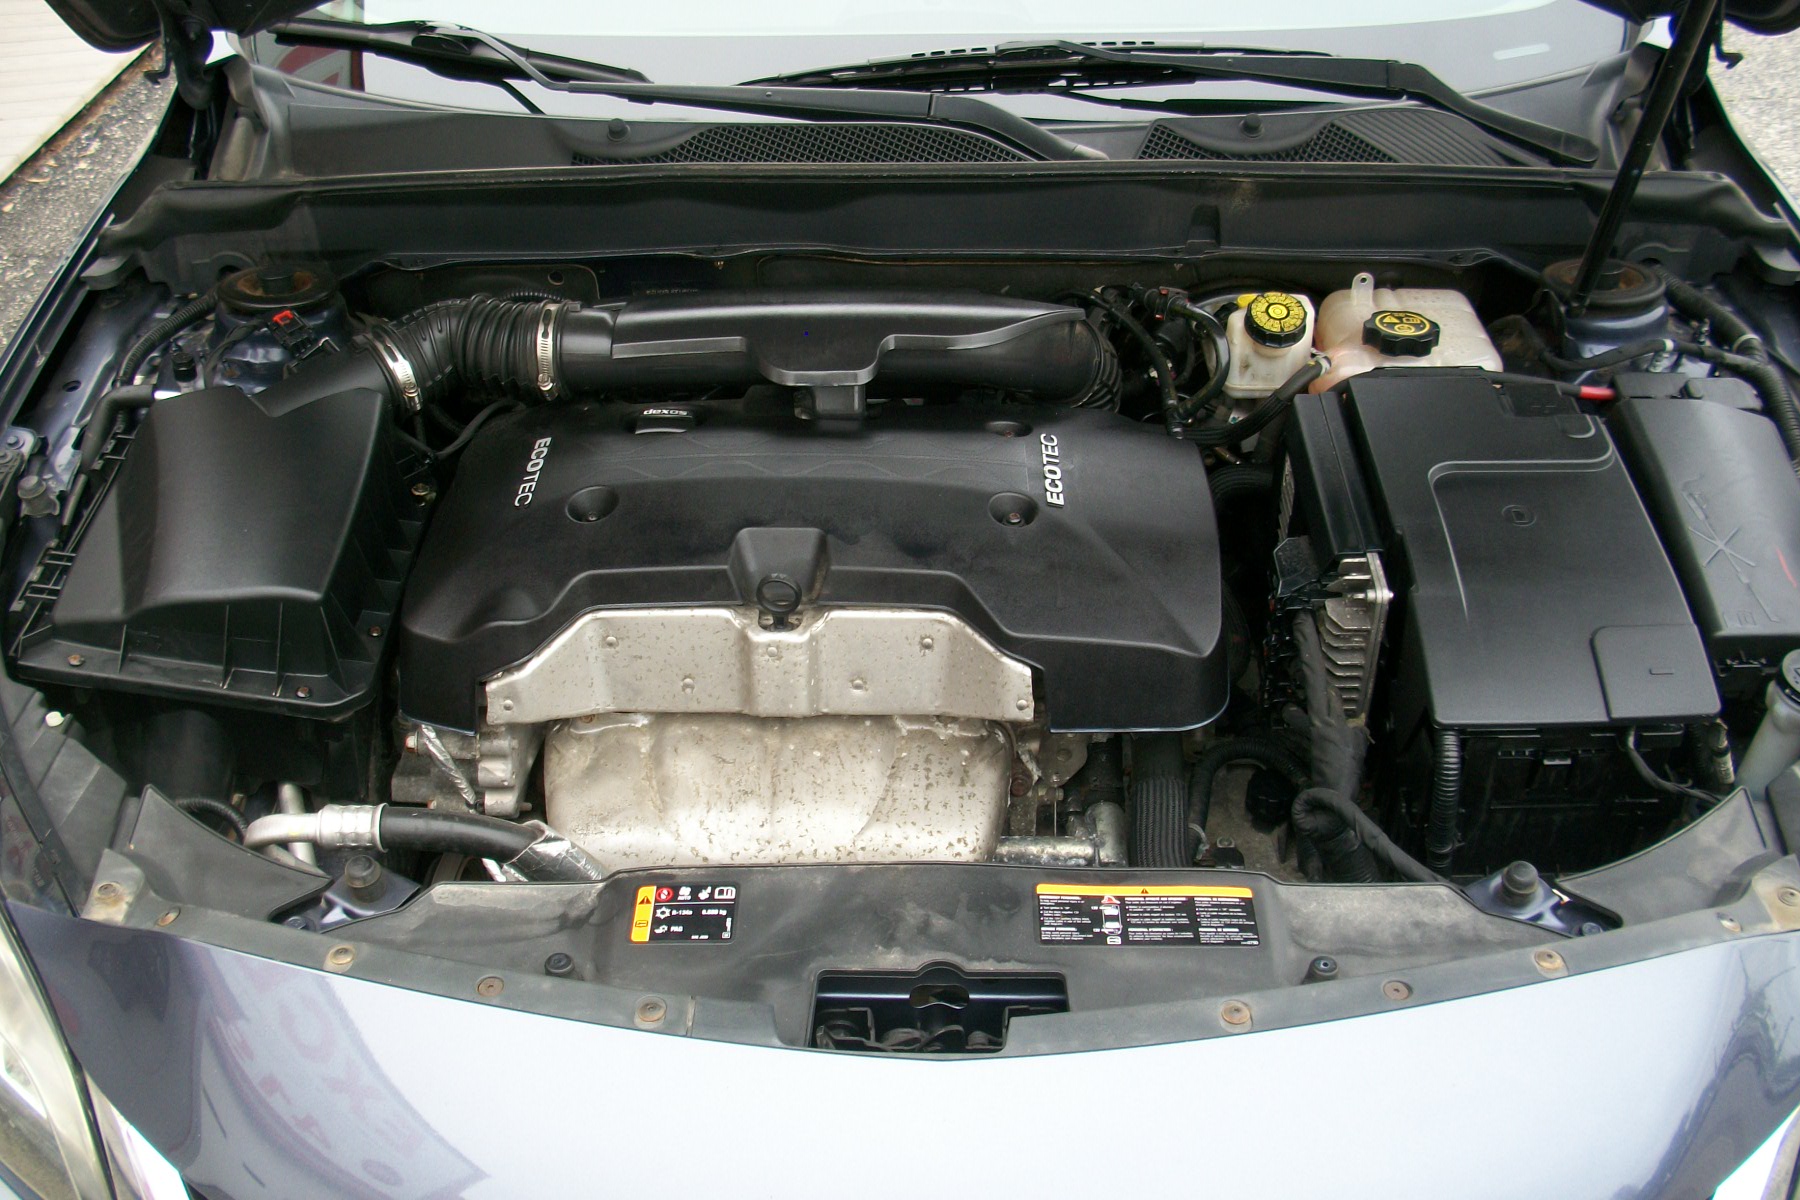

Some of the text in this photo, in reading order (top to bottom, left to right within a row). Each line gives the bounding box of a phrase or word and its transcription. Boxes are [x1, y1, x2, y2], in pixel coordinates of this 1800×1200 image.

[643, 408, 688, 416] dexos
[514, 437, 552, 507] ECOTEC
[1040, 433, 1065, 505] ECOTEC
